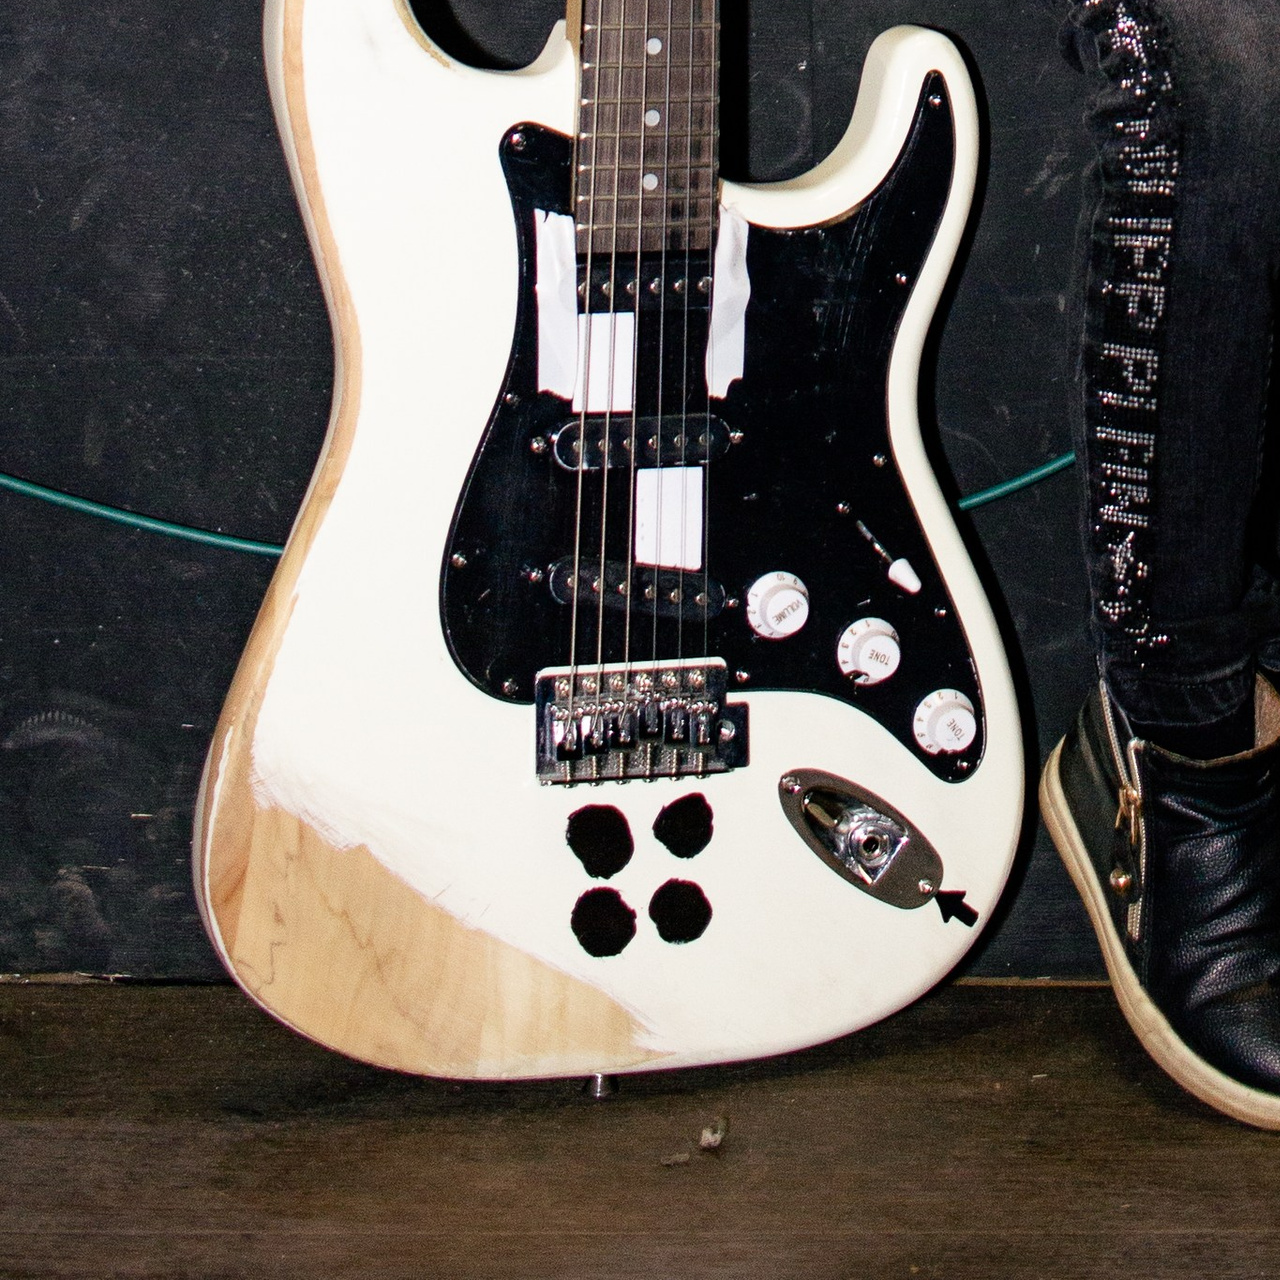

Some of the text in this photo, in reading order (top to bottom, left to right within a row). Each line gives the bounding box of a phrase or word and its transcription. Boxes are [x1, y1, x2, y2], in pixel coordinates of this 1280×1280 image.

[772, 599, 804, 626] VOLUME
[867, 648, 891, 666] TONE
[946, 717, 966, 743] TONE
